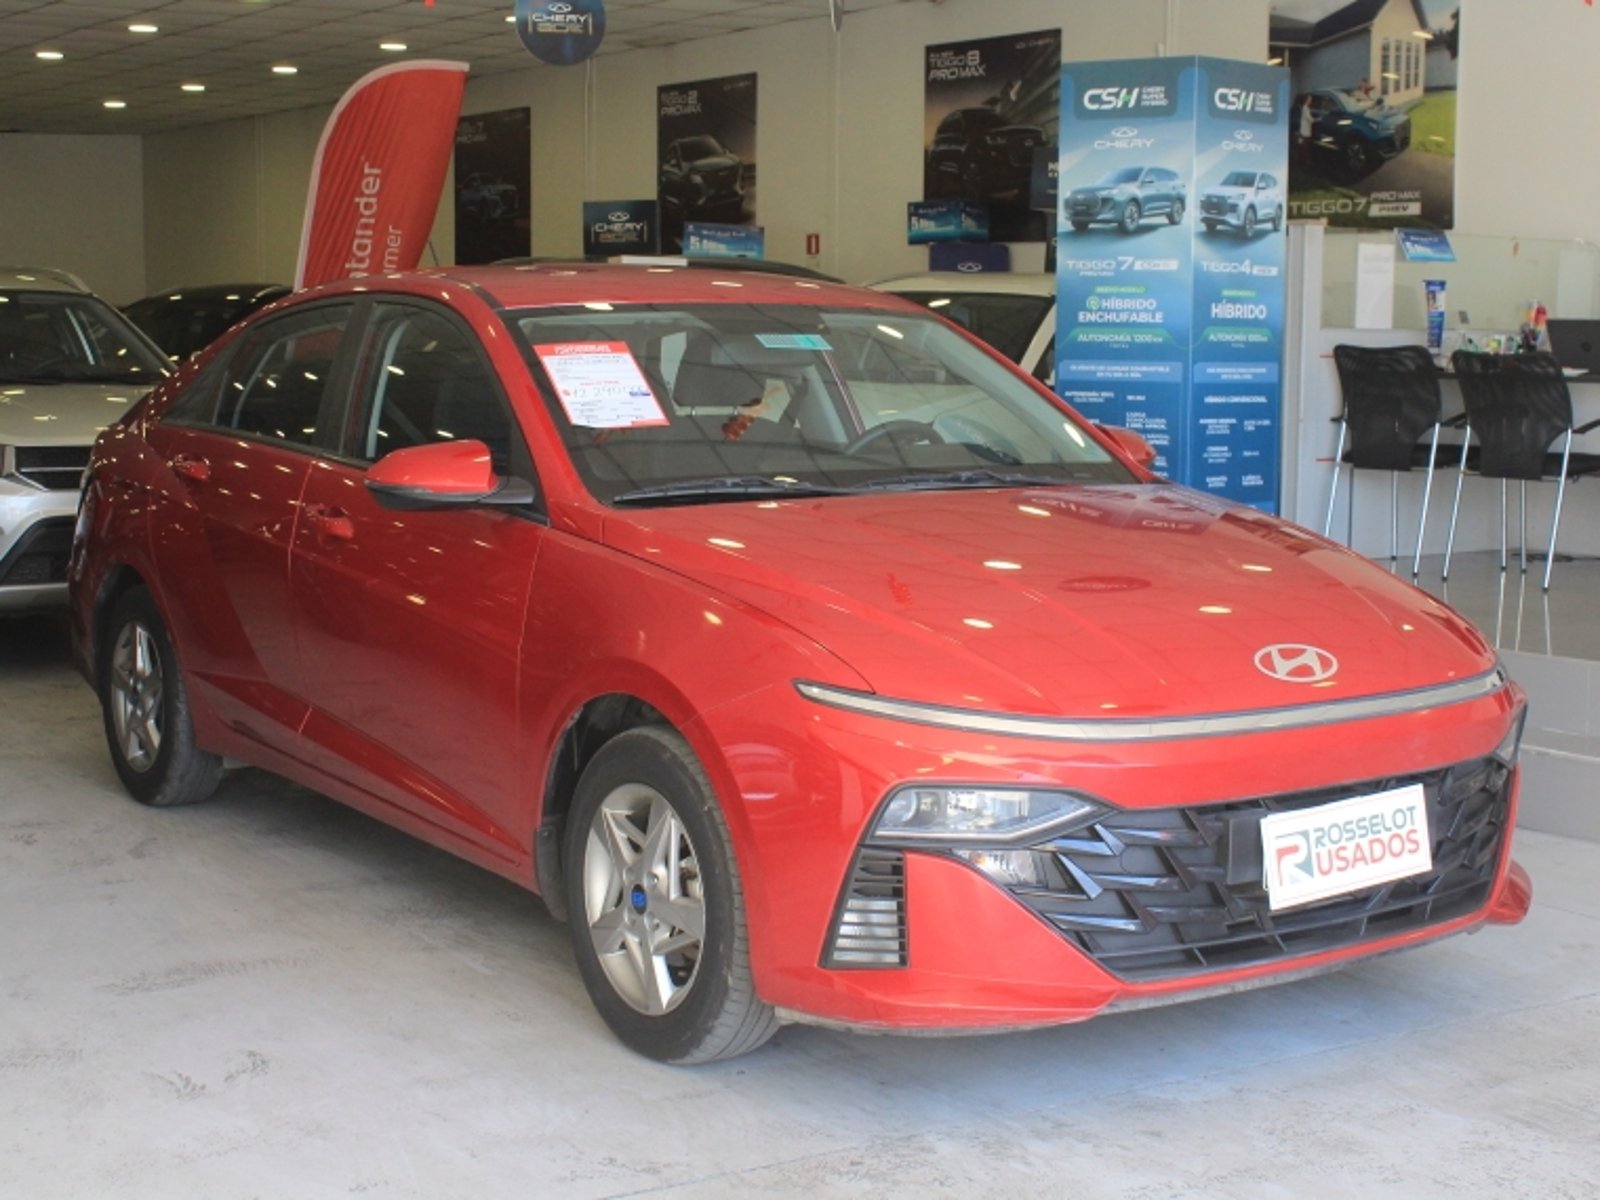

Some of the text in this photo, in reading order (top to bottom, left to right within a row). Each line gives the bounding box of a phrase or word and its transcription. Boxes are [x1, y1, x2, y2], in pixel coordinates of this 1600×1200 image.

[532, 13, 588, 23] CHERY
[1083, 87, 1140, 110] CSH
[1214, 87, 1255, 112] CSH
[1094, 138, 1155, 149] CHERY
[1220, 140, 1265, 152] CHERY
[1290, 198, 1366, 214] TIGGO 7
[595, 222, 643, 233] CHERY
[1066, 260, 1116, 270] TIGGO
[1117, 256, 1134, 270] 7
[1101, 296, 1157, 310] HÍBRIDO
[1211, 299, 1267, 319] HÍBRIDO
[1077, 311, 1164, 323] ENCHUFABLE
[1313, 805, 1417, 848] ROSSELOT
[1315, 828, 1420, 877] USADOS
